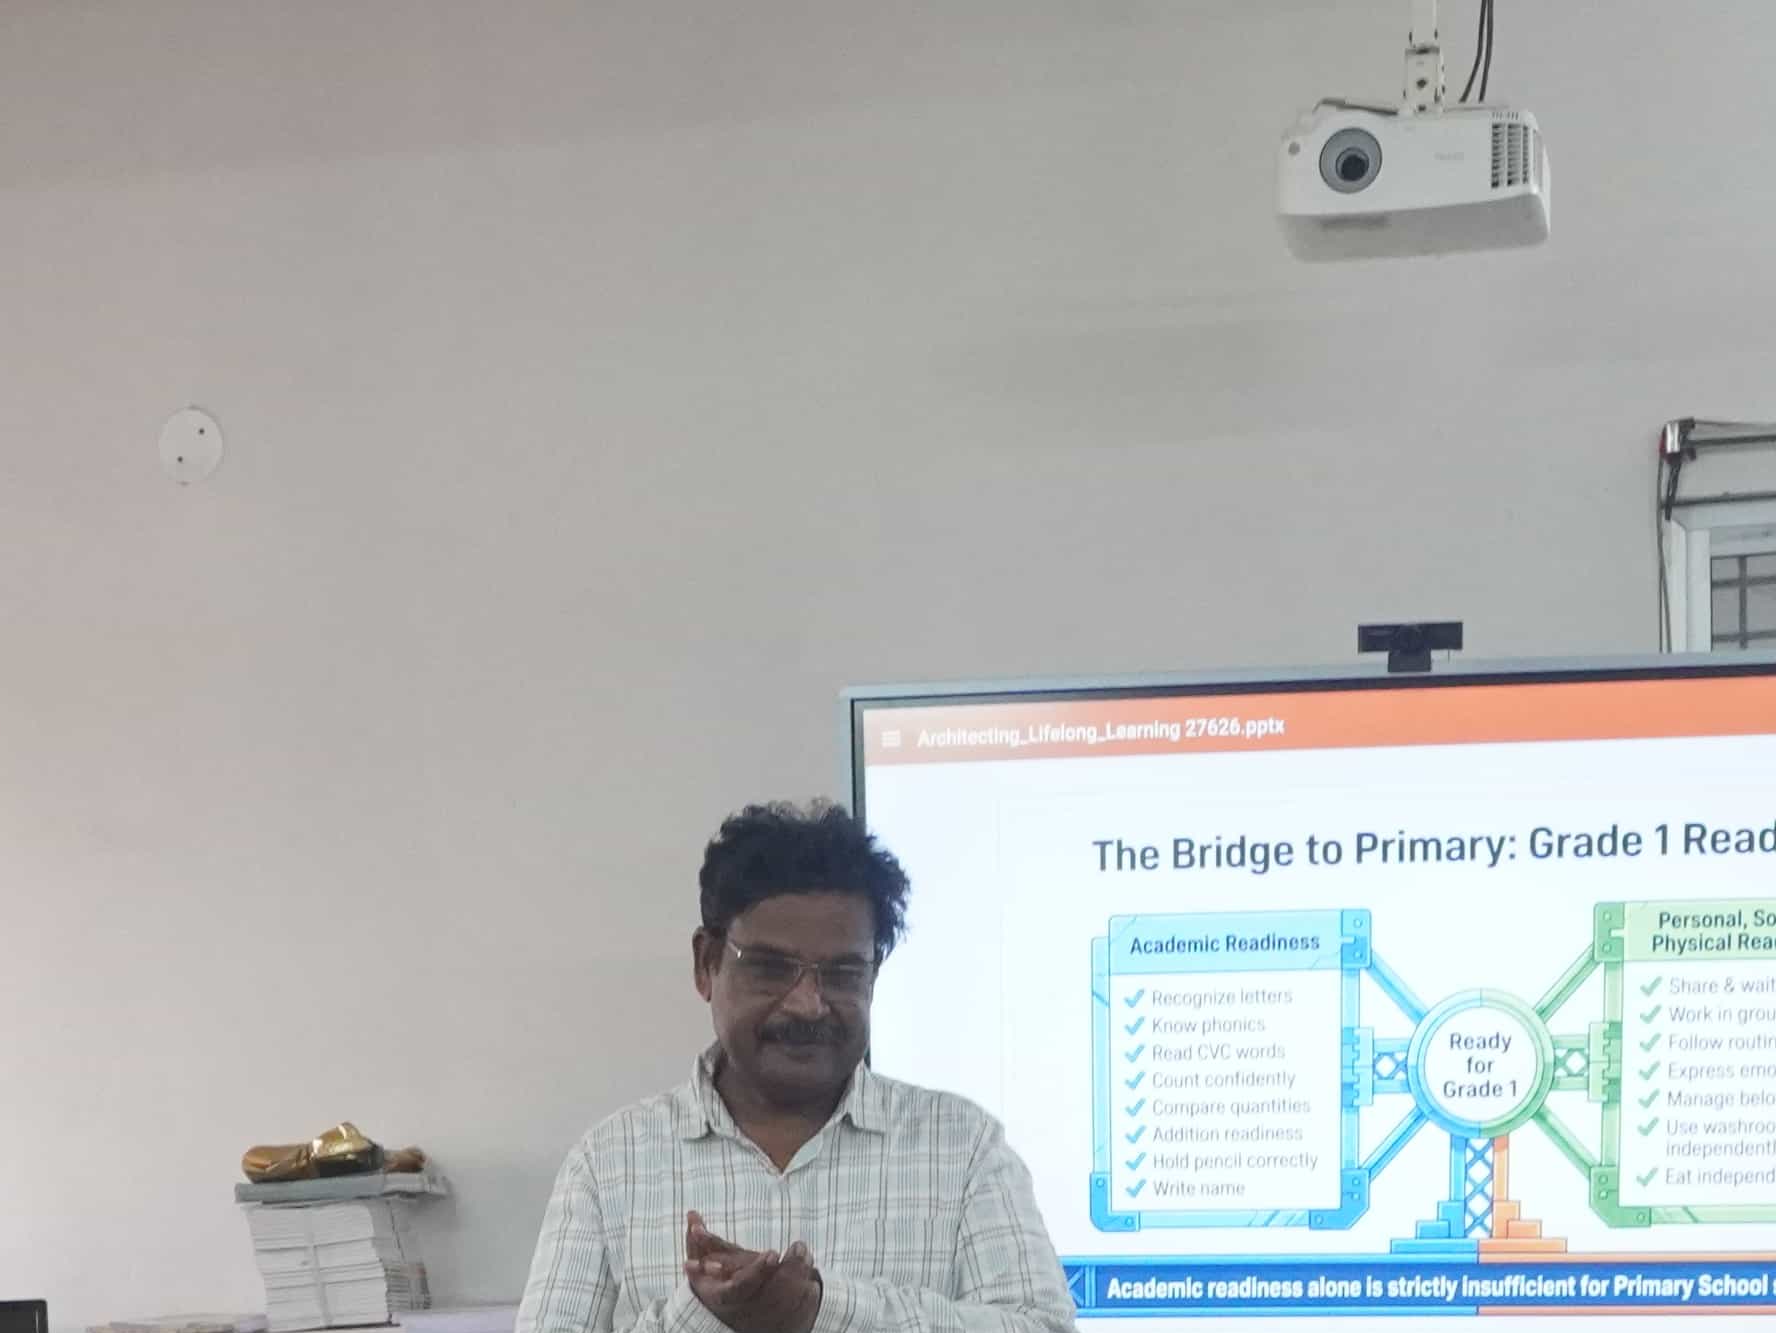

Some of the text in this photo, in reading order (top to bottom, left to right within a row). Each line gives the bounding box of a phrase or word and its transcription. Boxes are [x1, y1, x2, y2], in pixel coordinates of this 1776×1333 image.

[1185, 717, 1285, 738] 27626.pptx
[1092, 839, 1160, 872] The
[1173, 835, 1294, 875] Bridge
[1307, 835, 1343, 865] to
[1355, 830, 1516, 869] Primary:
[1529, 824, 1643, 860] Grade
[1656, 824, 1669, 855] 1
[1658, 911, 1747, 930] Personal,
[1129, 932, 1320, 955] Academic Readiness
[1652, 933, 1732, 955] Physical
[1669, 977, 1718, 994] Share
[1724, 977, 1735, 993] &
[1741, 977, 1776, 993] wait
[1152, 988, 1293, 1010] Recognize letters
[1669, 1006, 1711, 1023] Work
[1718, 1006, 1732, 1021] in
[1152, 1016, 1266, 1036] Know phonics
[1450, 1032, 1512, 1054] Ready
[1669, 1033, 1723, 1050] Follow
[1152, 1044, 1286, 1061] Read CVC words
[1467, 1056, 1495, 1074] for
[1668, 1063, 1734, 1080] Express
[1152, 1071, 1296, 1089] Count confidently
[1443, 1080, 1517, 1098] Grade 1
[1152, 1098, 1311, 1117] Compare quantities
[1667, 1090, 1734, 1110] Manage
[1153, 1125, 1303, 1143] Addition readiness
[1667, 1119, 1698, 1135] Use
[1153, 1152, 1318, 1172] Hold pencil correctly
[1665, 1168, 1692, 1184] Eat
[1153, 1181, 1245, 1197] Write name
[1107, 1277, 1203, 1299] Academic
[1207, 1276, 1303, 1298] readiness
[1308, 1276, 1362, 1297] alone
[1366, 1276, 1383, 1297] is
[1387, 1275, 1458, 1301] strictly
[1462, 1275, 1576, 1297] insufficient
[1581, 1275, 1608, 1297] for
[1614, 1274, 1694, 1301] Primary
[1698, 1274, 1768, 1295] School
